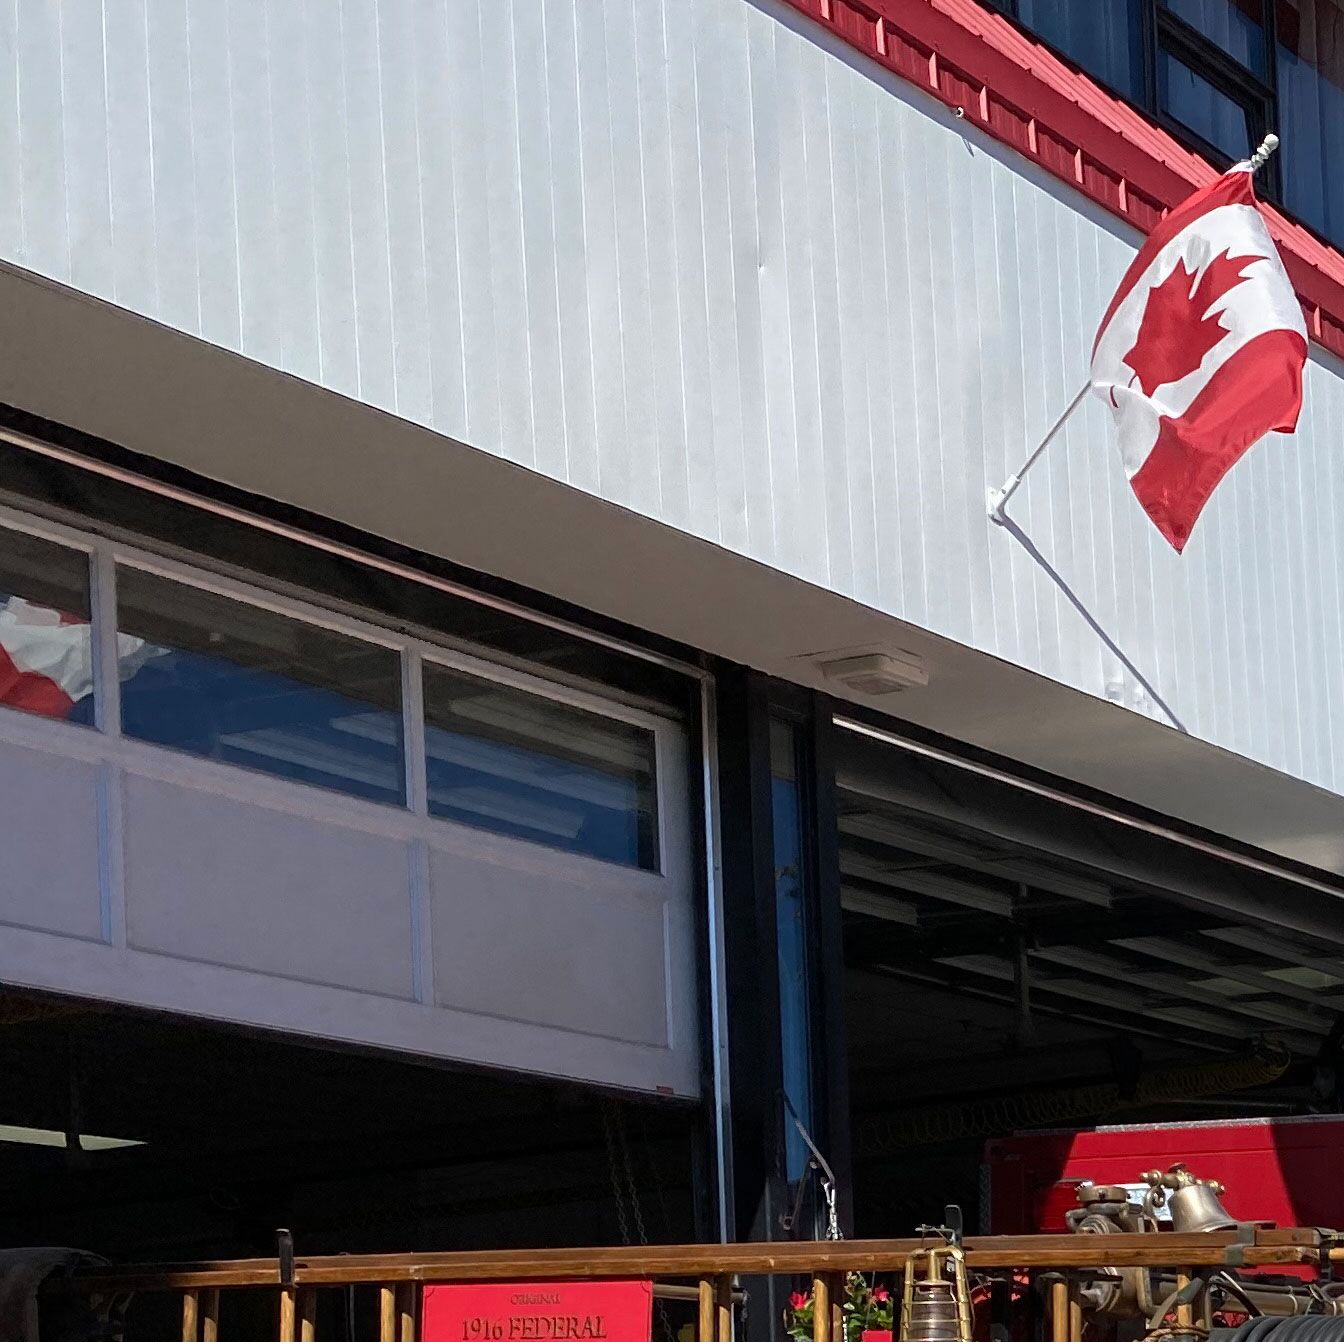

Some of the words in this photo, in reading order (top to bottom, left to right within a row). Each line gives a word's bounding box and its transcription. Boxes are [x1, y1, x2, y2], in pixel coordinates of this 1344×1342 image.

[509, 1293, 561, 1305] ORIGINAL
[462, 1317, 503, 1341] 1916
[508, 1315, 608, 1340] FEDERAL
